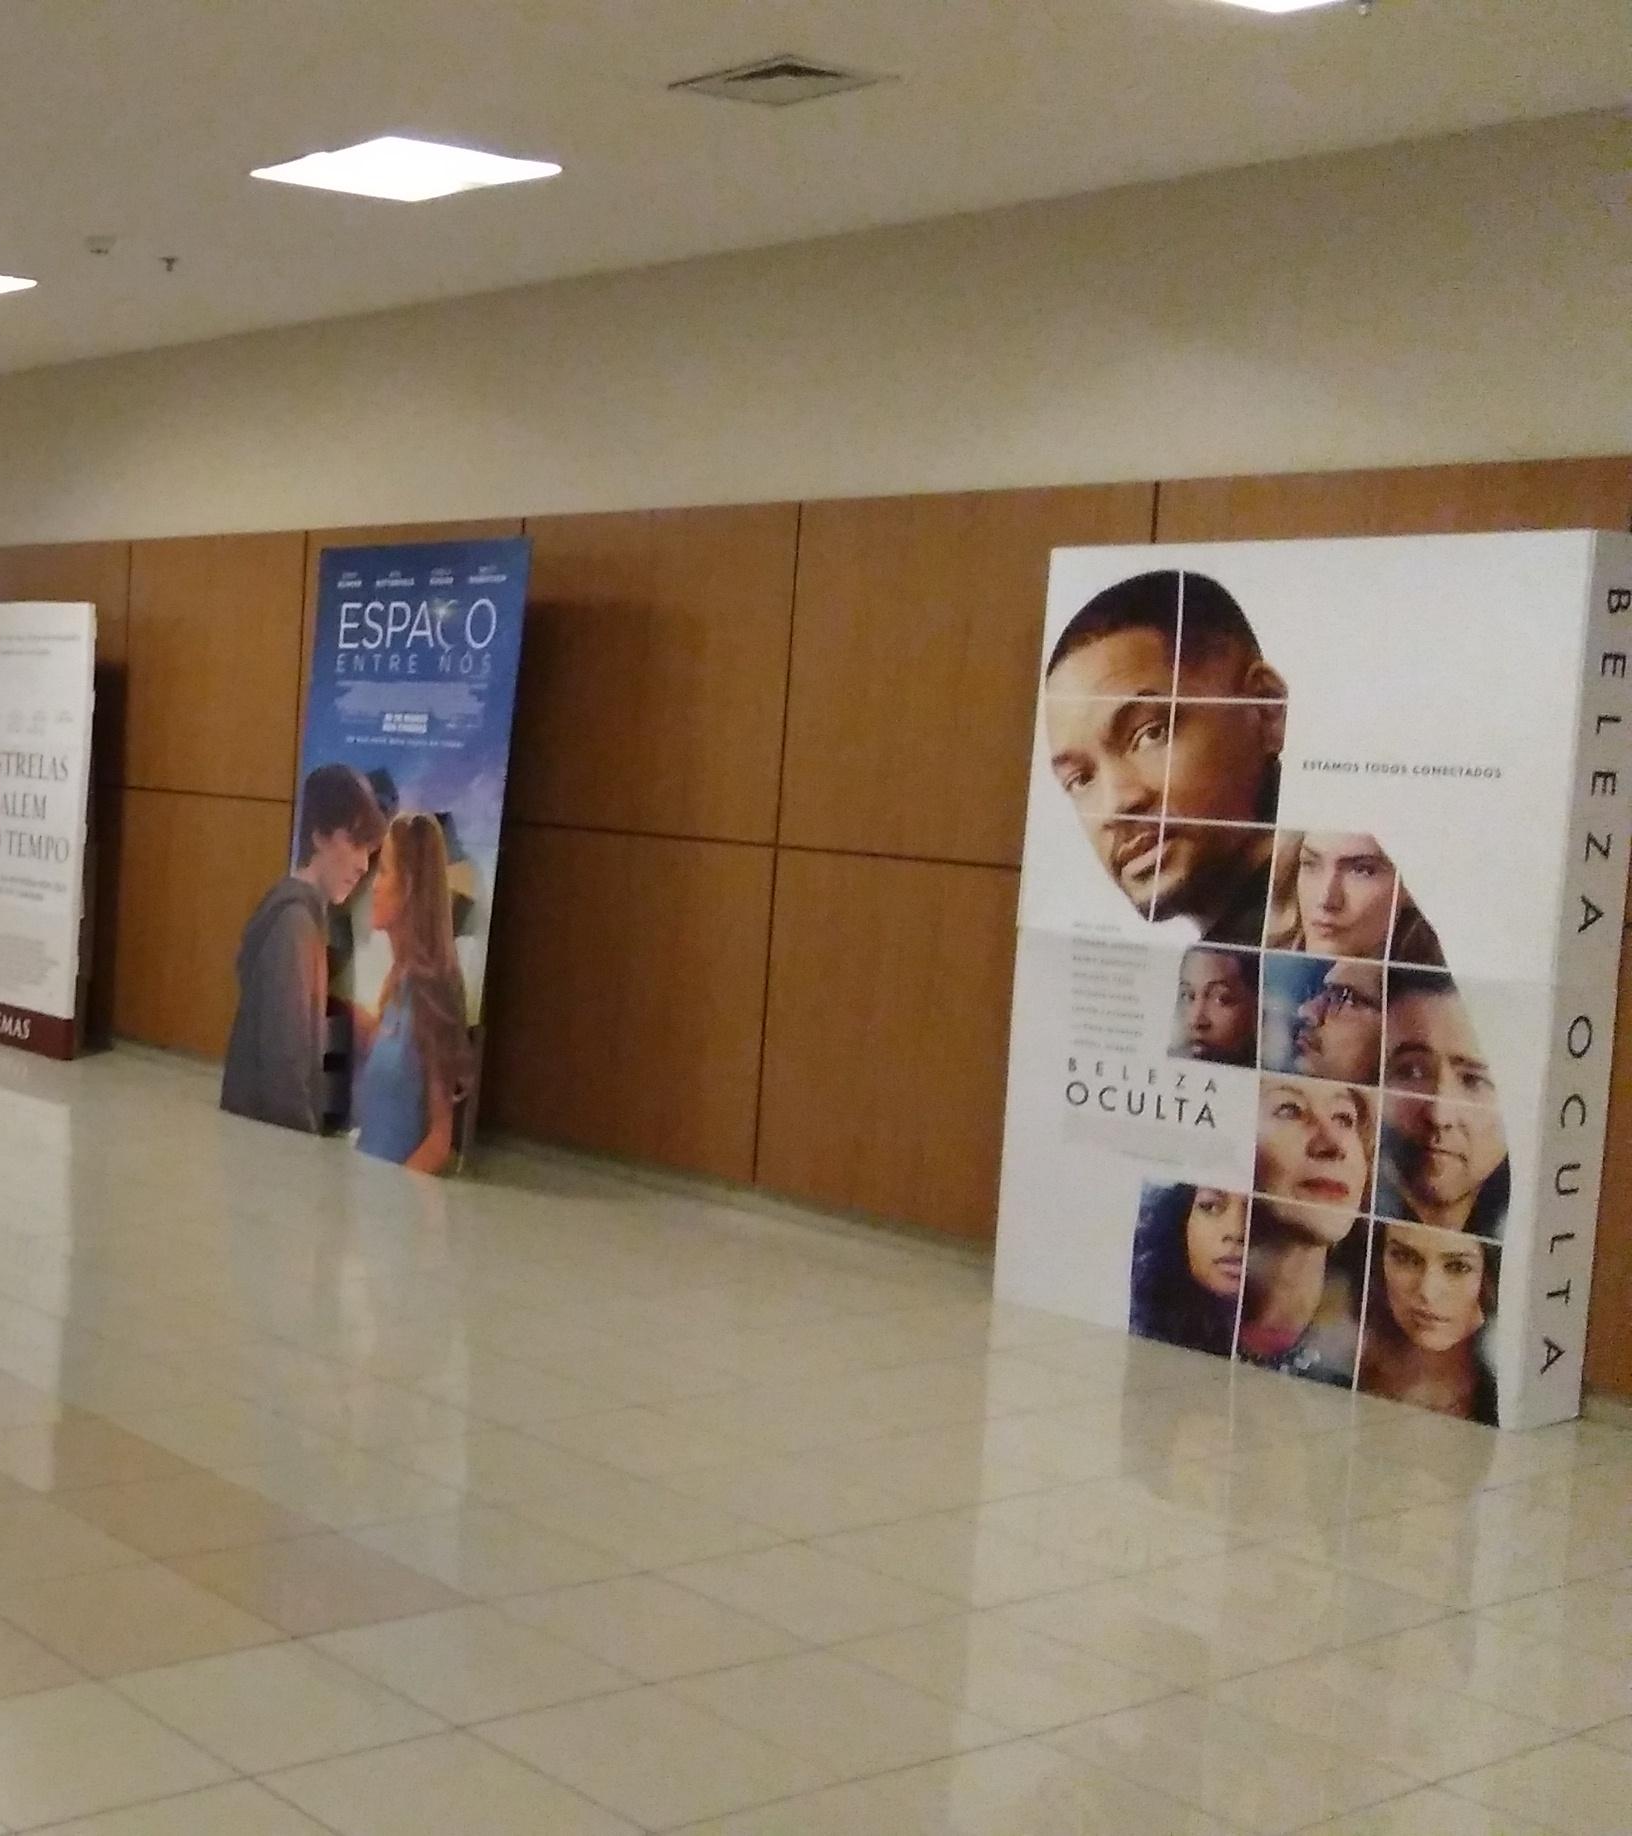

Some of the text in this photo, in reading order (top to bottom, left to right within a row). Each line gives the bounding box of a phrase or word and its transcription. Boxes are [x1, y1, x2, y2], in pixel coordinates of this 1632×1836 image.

[337, 598, 498, 653] ESPAÇO
[334, 653, 419, 674] ENTRE
[1302, 760, 1504, 780] ESTAMOS TODOS CONECTADOS
[6, 829, 70, 863] TEMPO
[1540, 587, 1632, 1375] BELEZA OCULTA
[1067, 1056, 1218, 1094] BELEZA
[1065, 1081, 1217, 1130] OCULTA
